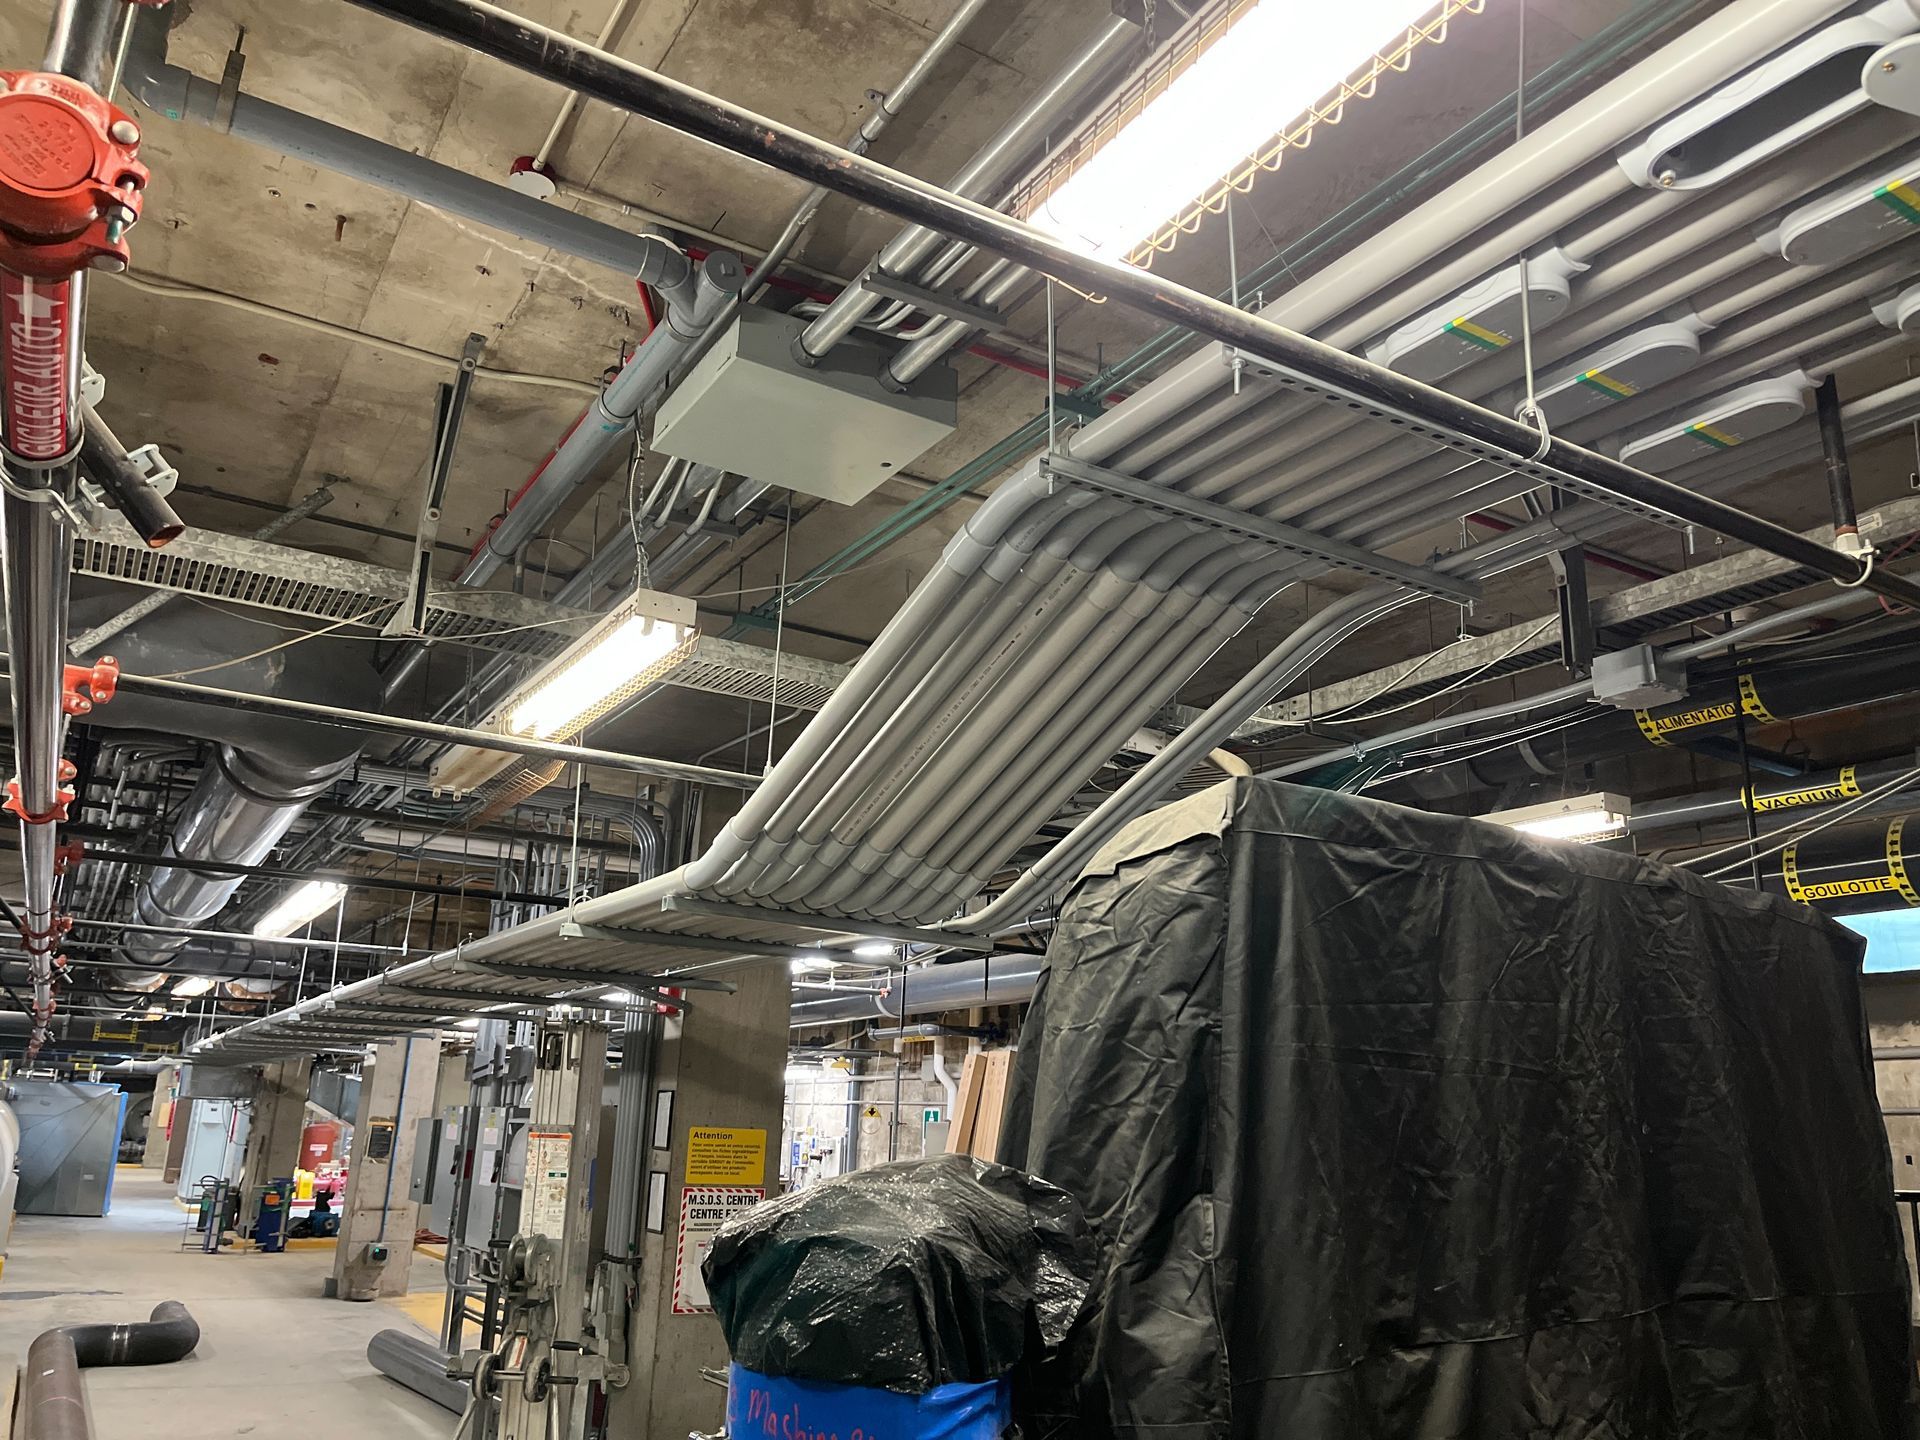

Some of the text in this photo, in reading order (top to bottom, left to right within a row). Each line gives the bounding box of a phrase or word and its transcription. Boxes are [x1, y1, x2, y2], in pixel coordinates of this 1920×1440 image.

[10, 319, 62, 457] GICLEUR AUTO.
[1655, 703, 1745, 731] ALIMENTATIO
[1759, 788, 1844, 809] VACUUM
[1803, 878, 1893, 898] GOULOTTE
[693, 1131, 733, 1140] Attention
[688, 1194, 759, 1206] M.S.D.S. CENTRE
[690, 1208, 723, 1219] CENTRE
